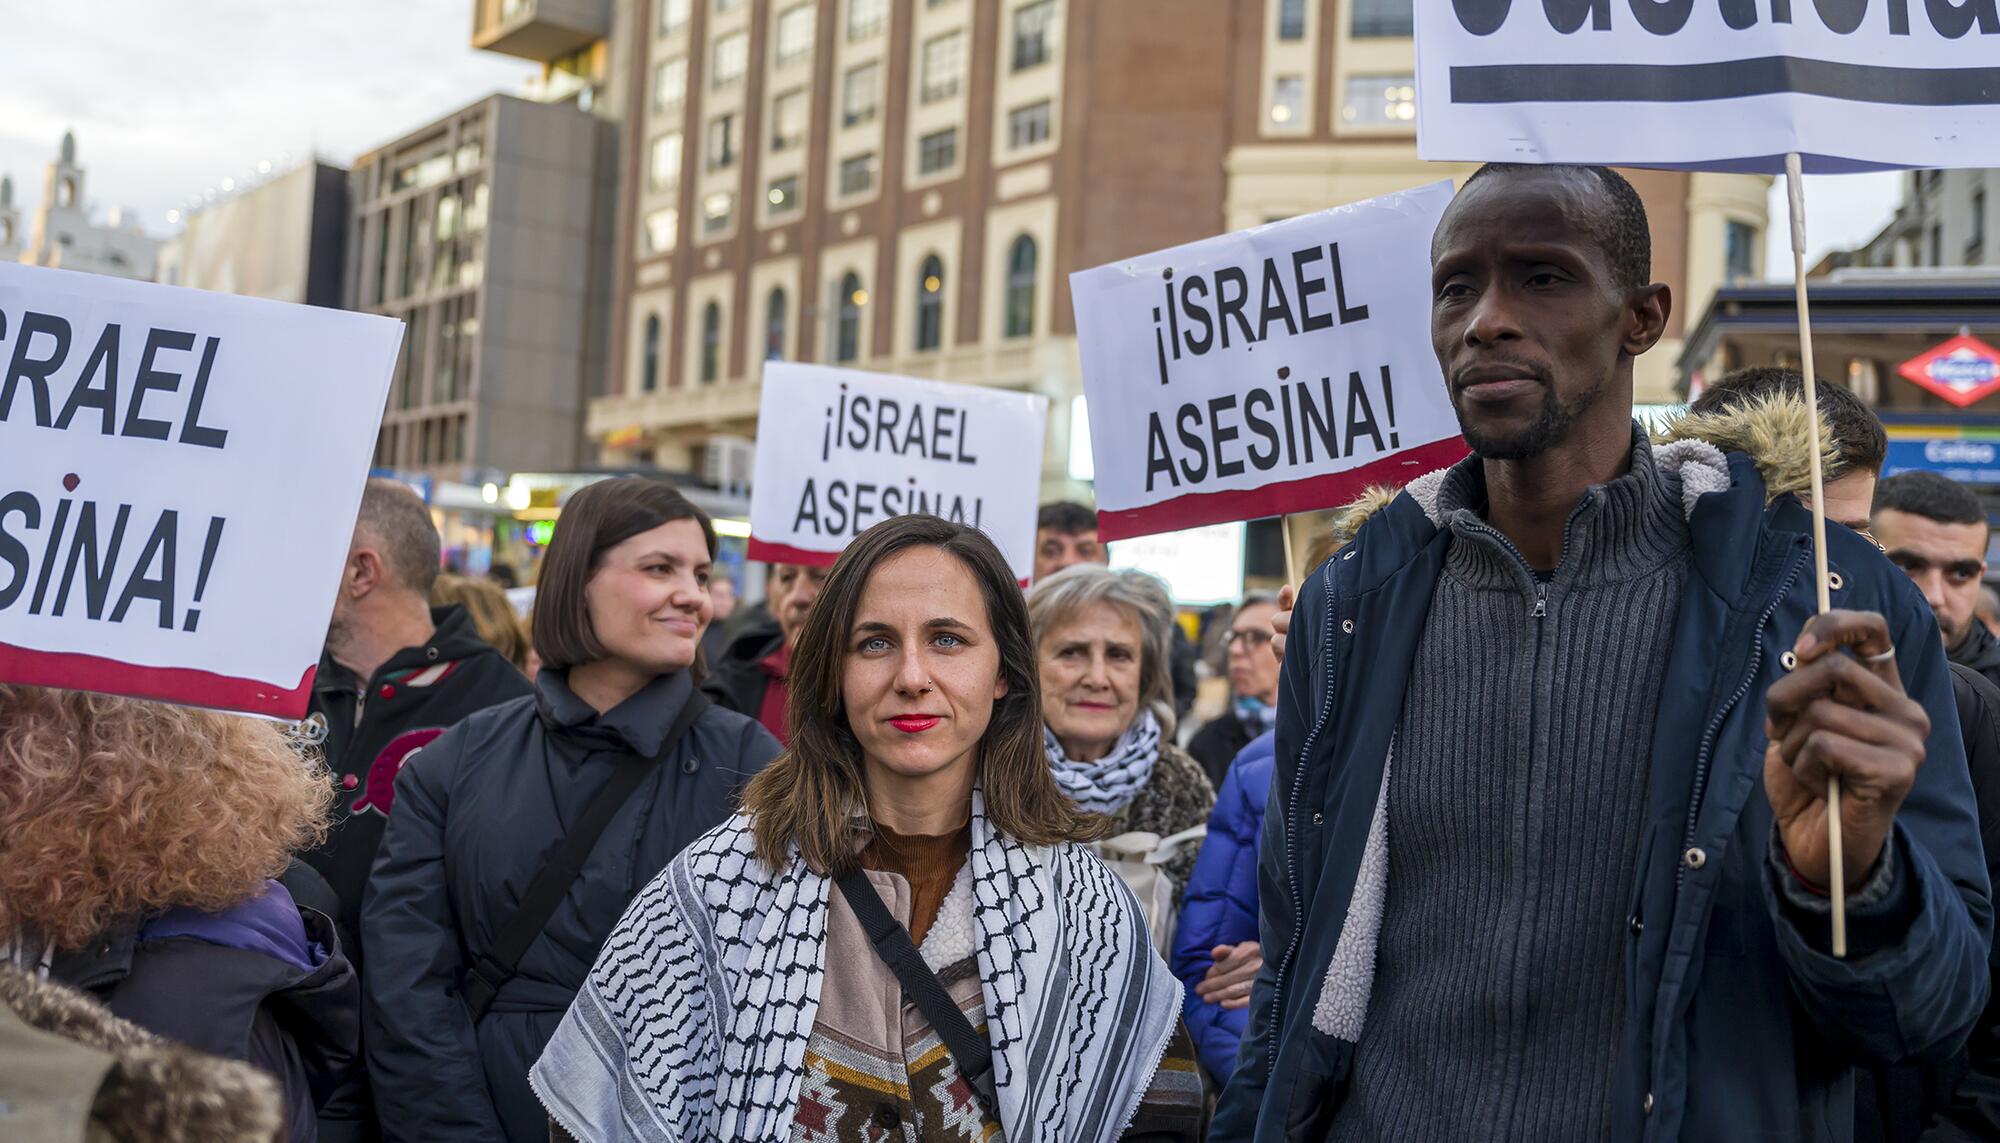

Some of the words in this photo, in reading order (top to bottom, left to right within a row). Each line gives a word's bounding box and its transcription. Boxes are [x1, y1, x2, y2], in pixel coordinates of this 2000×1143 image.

[0, 308, 228, 449] RAEL
[1153, 242, 1369, 385] ¡ISRAEL
[1146, 365, 1400, 492] ASESINA!
